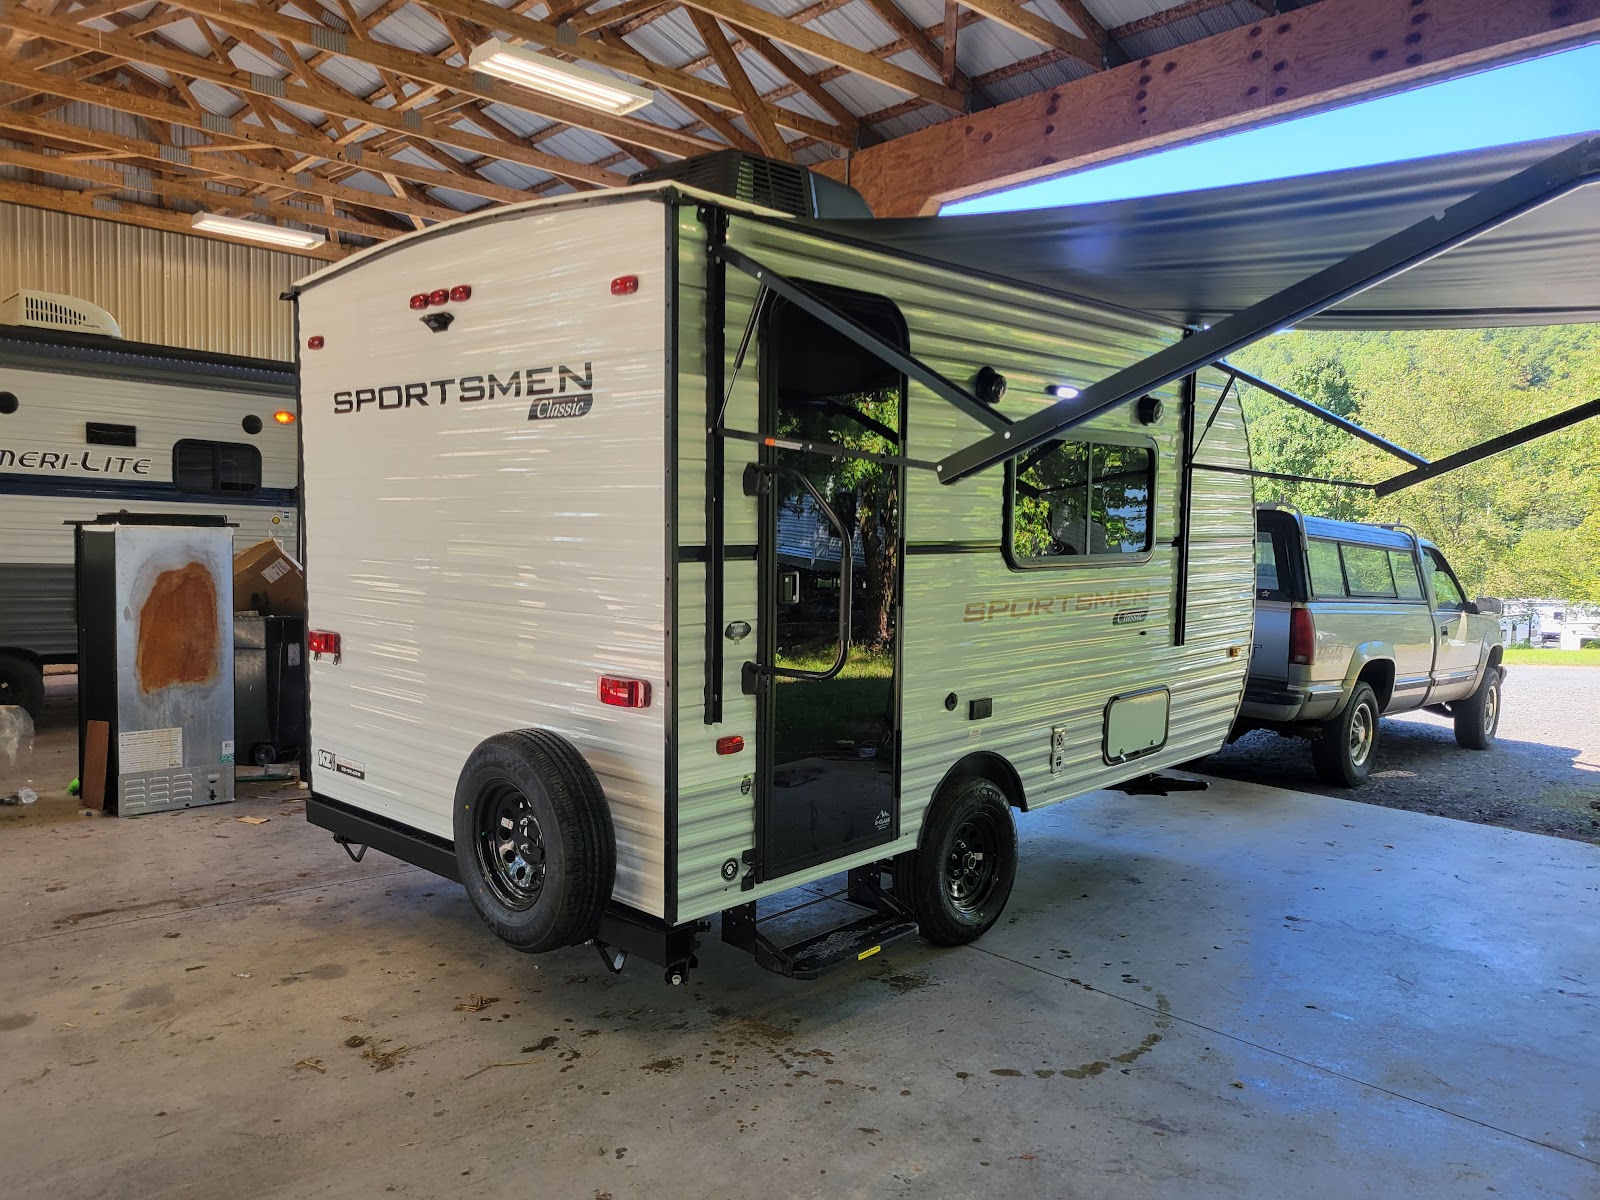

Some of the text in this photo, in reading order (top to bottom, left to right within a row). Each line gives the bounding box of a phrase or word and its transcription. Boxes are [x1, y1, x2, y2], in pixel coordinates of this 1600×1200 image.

[333, 361, 593, 415] SPORTSMEN
[536, 397, 584, 419] Classic
[963, 588, 1150, 623] SPORTSMEN
[1117, 611, 1144, 624] Classic
